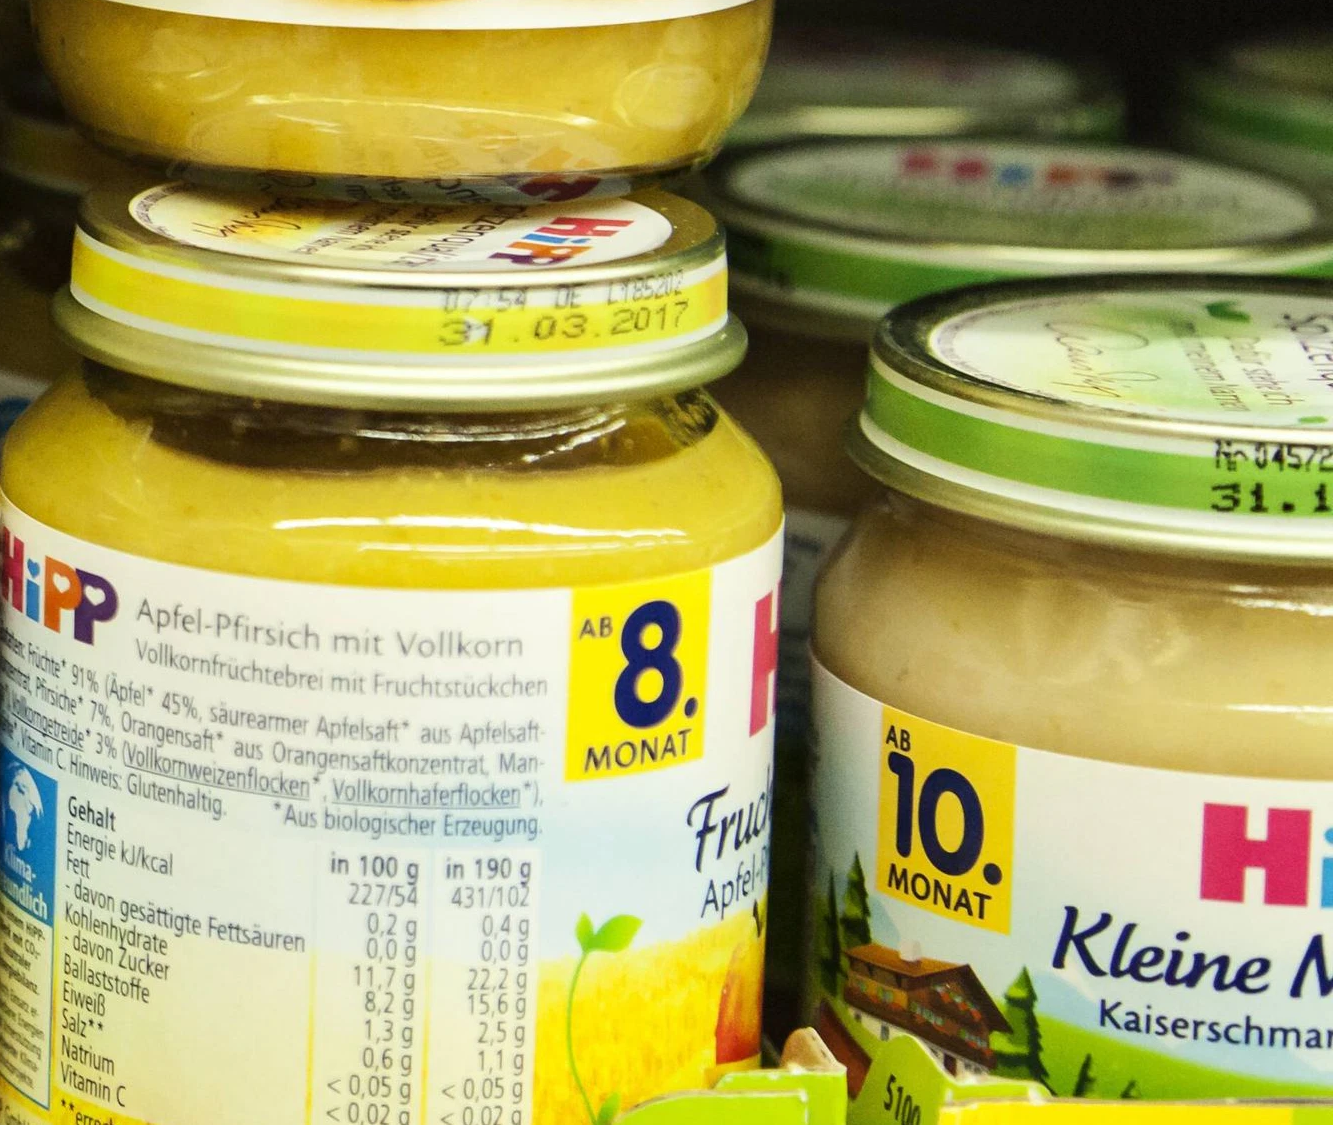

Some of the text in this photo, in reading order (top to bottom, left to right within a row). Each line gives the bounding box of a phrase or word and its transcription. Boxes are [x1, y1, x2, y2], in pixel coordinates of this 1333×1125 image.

[438, 300, 689, 347] 31.03.2017
[1, 526, 119, 646] HiPP
[396, 627, 523, 661] Vollkorn
[578, 614, 613, 641] AB
[613, 599, 699, 730] 8.
[584, 728, 693, 772] MONAT
[885, 725, 912, 753] AB
[887, 750, 1003, 887] 10.
[886, 862, 993, 922] MONAT
[1051, 905, 1272, 996] Kleine
